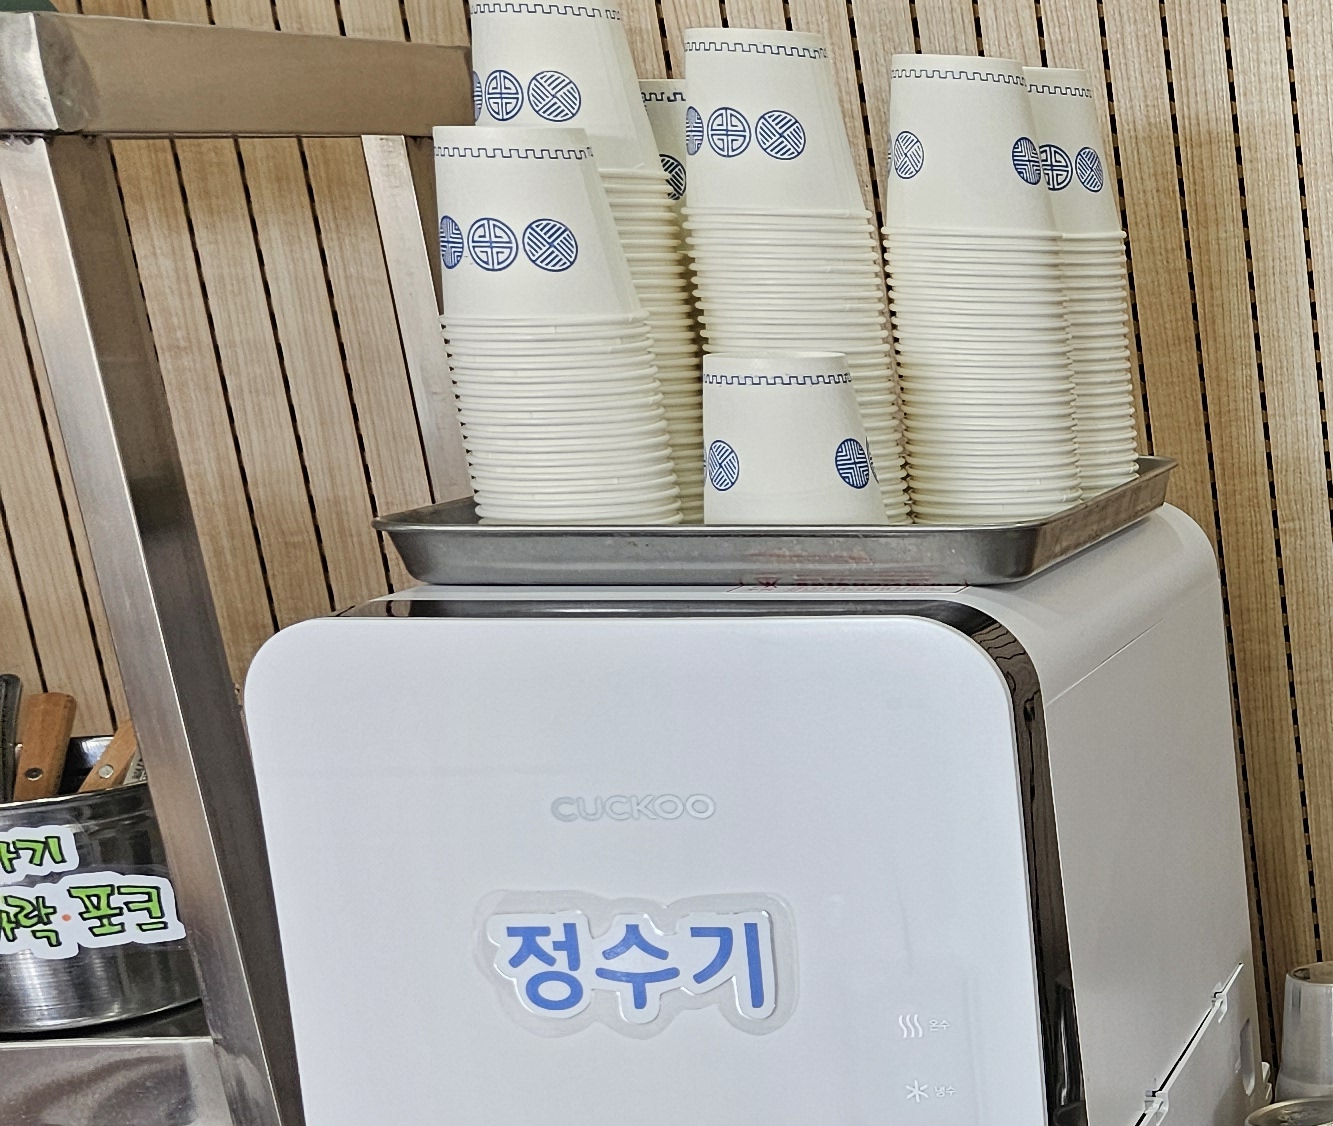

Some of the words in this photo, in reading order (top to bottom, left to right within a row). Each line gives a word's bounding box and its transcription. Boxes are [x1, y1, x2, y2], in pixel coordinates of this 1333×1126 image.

[551, 794, 716, 822] CUCKOO
[506, 922, 766, 1011] 정수기
[928, 1018, 951, 1032] 온수
[933, 1085, 957, 1098] 냉수
